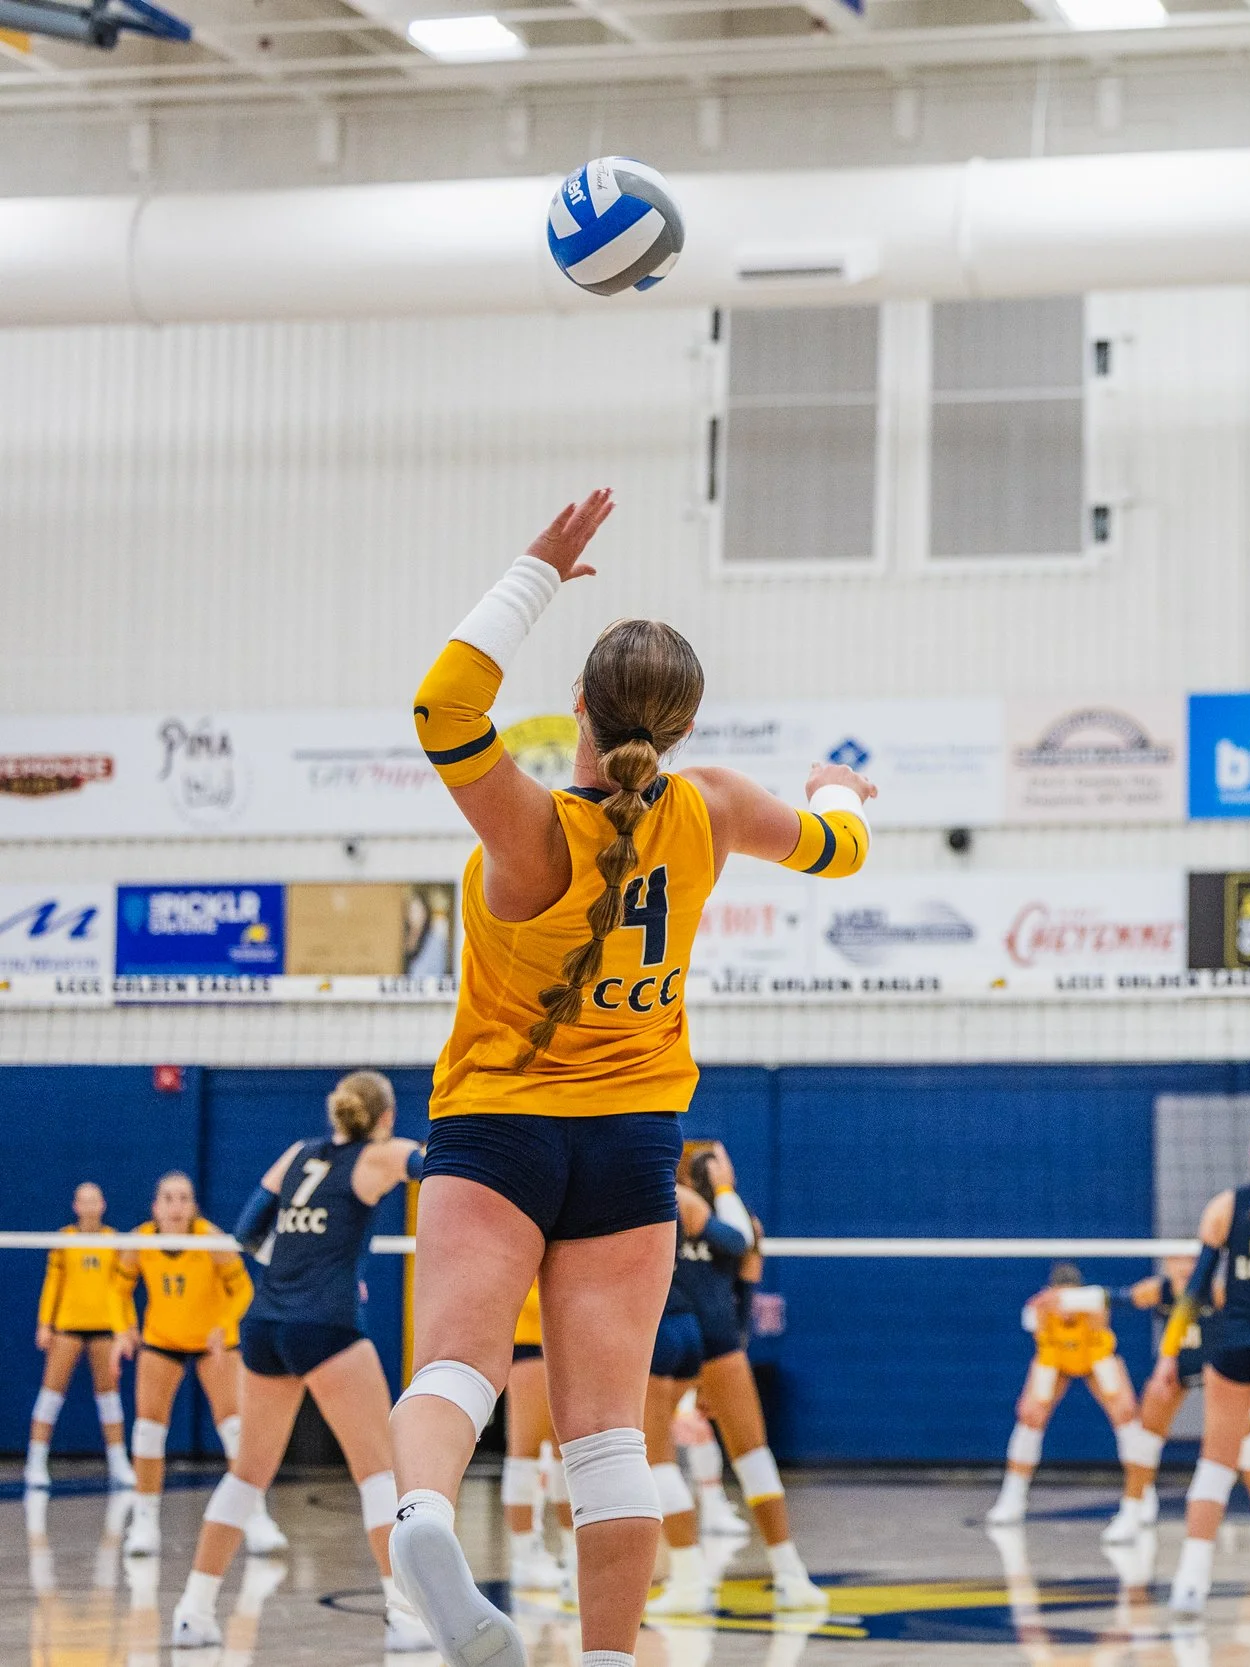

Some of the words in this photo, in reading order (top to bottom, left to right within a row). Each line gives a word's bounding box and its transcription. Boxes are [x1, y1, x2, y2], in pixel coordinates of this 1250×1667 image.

[621, 864, 670, 969] 4
[582, 967, 681, 1013] CCC
[290, 1157, 332, 1207] 7
